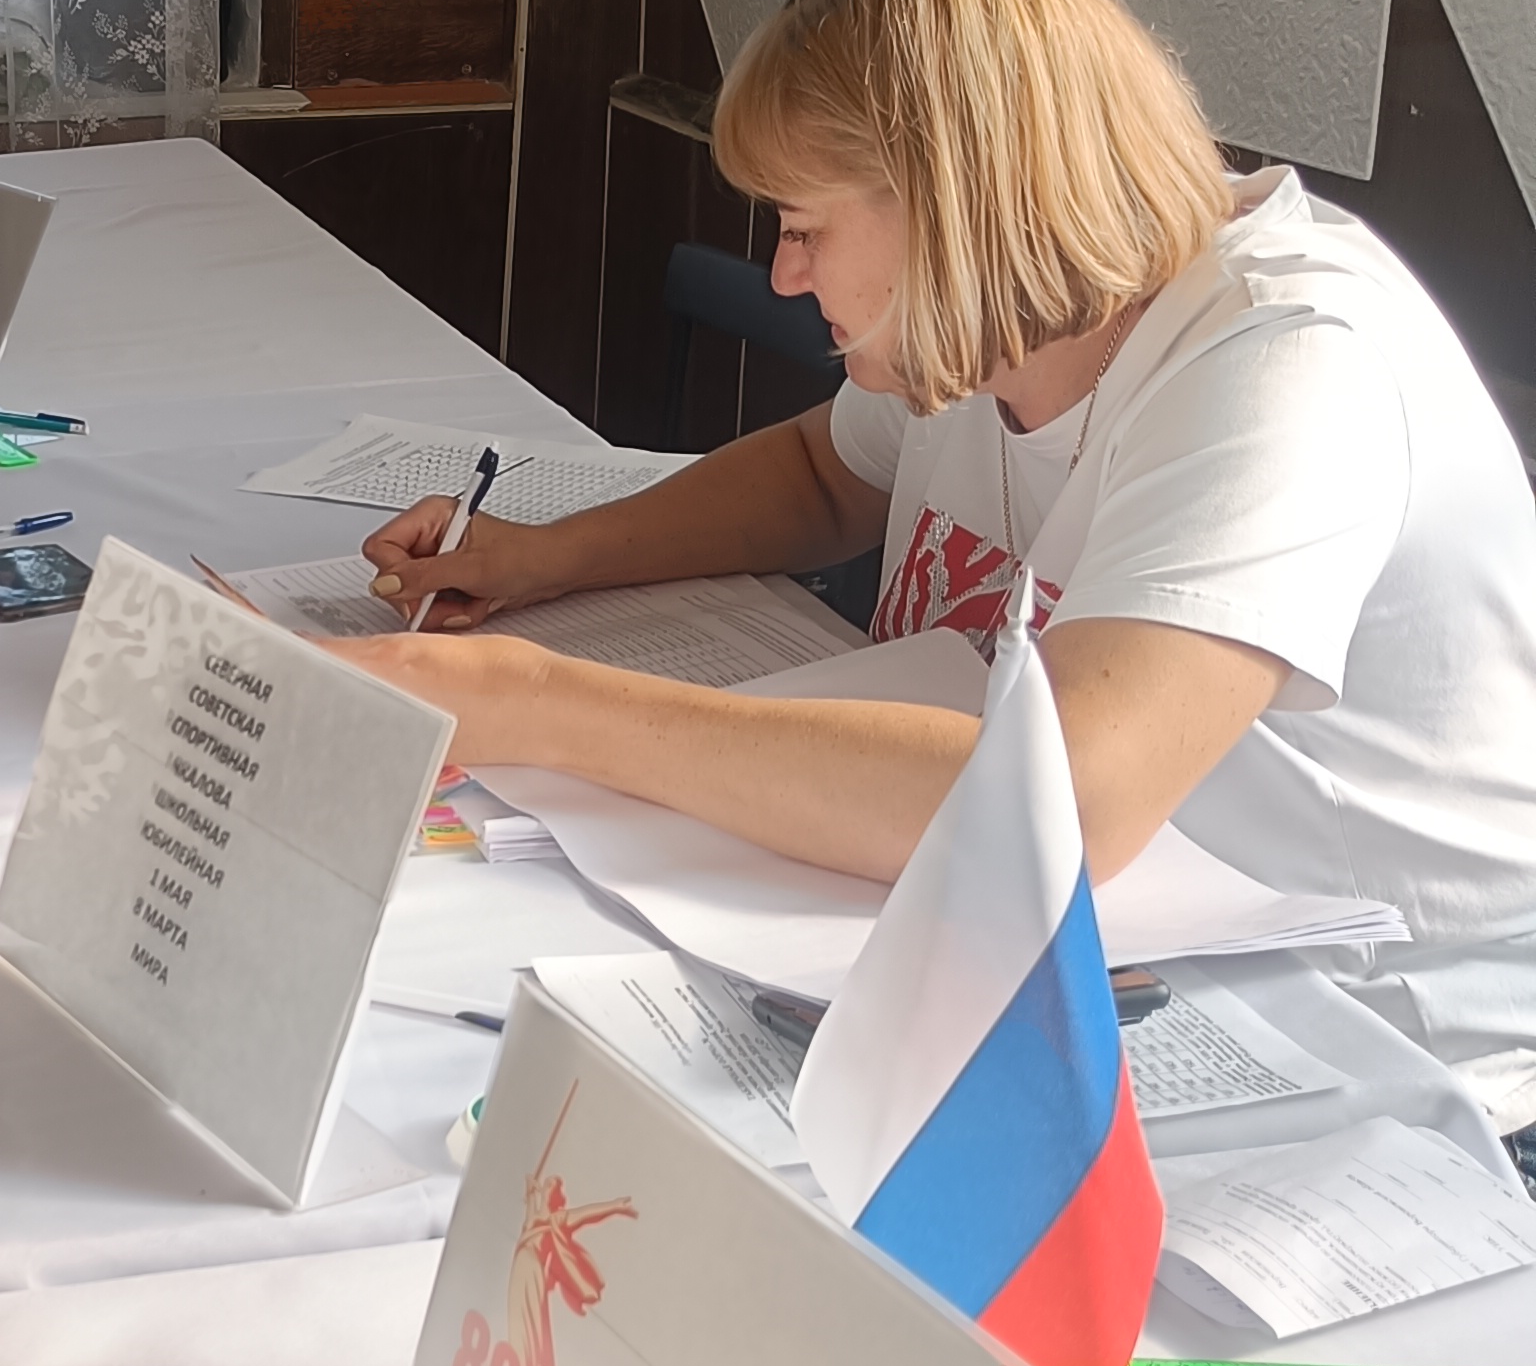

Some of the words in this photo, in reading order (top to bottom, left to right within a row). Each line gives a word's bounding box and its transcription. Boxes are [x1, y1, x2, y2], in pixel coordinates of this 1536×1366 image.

[204, 654, 273, 704] СЕВЕРНАЯ
[188, 684, 266, 742] СОВЕТСКАЯ
[171, 715, 260, 782] СПОРТИВНАЯ
[172, 756, 232, 810] ЧКАЛОВА
[154, 787, 231, 851] ШКОЛЬНАЯ
[140, 819, 225, 890] ЮБИЛЕЙНАЯ
[149, 868, 160, 887] 1
[158, 874, 193, 910] МАЯ
[132, 896, 144, 917] 8
[142, 903, 189, 951] МАРТА
[130, 942, 169, 986] МИРА
